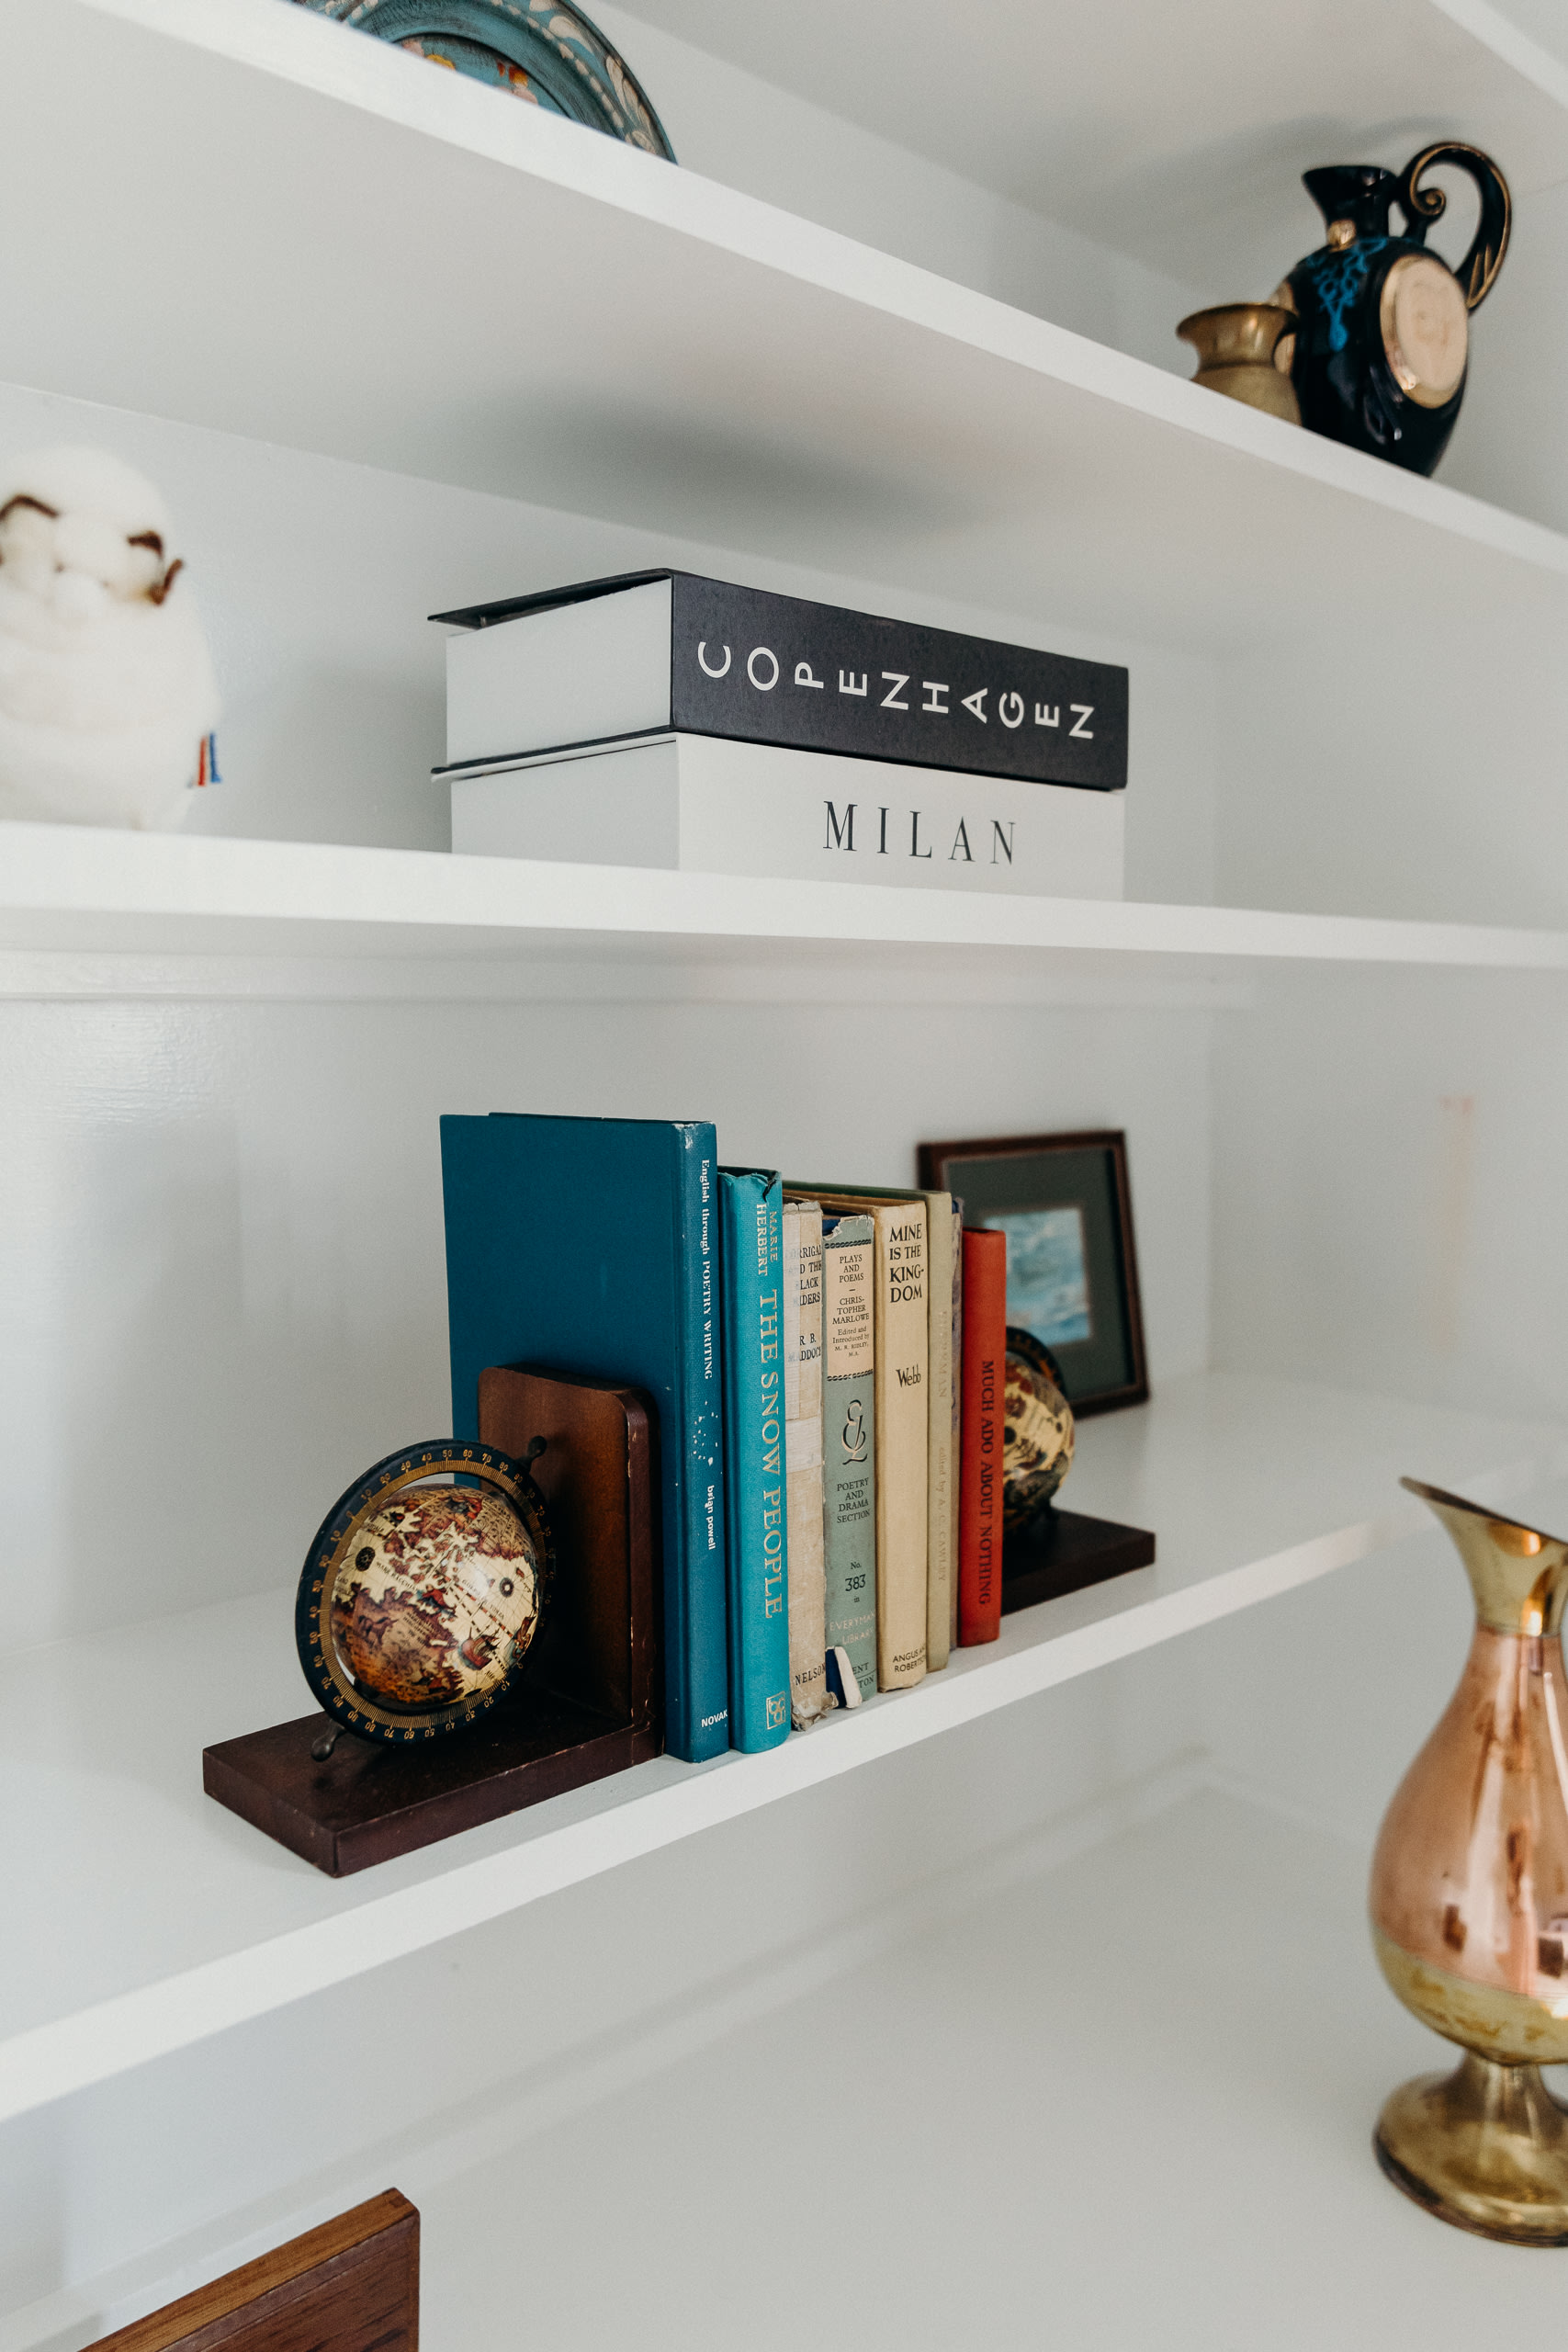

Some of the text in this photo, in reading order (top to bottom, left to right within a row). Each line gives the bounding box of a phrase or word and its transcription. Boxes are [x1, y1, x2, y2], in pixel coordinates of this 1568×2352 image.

[696, 640, 1095, 740] COPENHAGEN
[822, 800, 1016, 865] MILAN
[769, 1211, 778, 1263] MARIE
[889, 1223, 922, 1242] MINE
[756, 1204, 768, 1277] HERBERT
[840, 1254, 863, 1264] PLAYS
[889, 1244, 921, 1261] IS THE
[700, 1159, 713, 1380] English through POETRY WRITING
[843, 1263, 860, 1274] AND
[889, 1263, 925, 1283] KING-
[796, 1277, 818, 1290] LACK
[839, 1272, 864, 1283] POEMS
[890, 1283, 922, 1304] DOM
[839, 1295, 865, 1306] CHRIS-
[837, 1305, 866, 1315] TOPHER
[832, 1313, 870, 1325] MARLOWE
[838, 1326, 867, 1336] Edited and
[832, 1335, 863, 1344] Introduced
[896, 1363, 921, 1388] Webb
[422, 1453, 433, 1462] 40
[442, 1449, 452, 1457] 50
[482, 1453, 492, 1463] 70
[760, 1288, 783, 1619] THE SNOW PEOPLE
[837, 1477, 870, 1492] POETRY
[978, 1361, 995, 1605] MUCH ADO ABOUT NOTHING
[844, 1489, 863, 1501] AND
[838, 1498, 869, 1512] DRAMA
[705, 1485, 716, 1551] brian powell
[837, 1510, 870, 1524] SECTION
[850, 1562, 862, 1570] No.
[845, 1574, 866, 1591] 383
[892, 1648, 919, 1663] ANGUS
[852, 1662, 869, 1675] ENT
[484, 1697, 494, 1708] 20
[466, 1711, 476, 1722] 30
[701, 1708, 728, 1728] NOVAK
[384, 1728, 394, 1738] 70
[403, 1730, 415, 1739] 60
[424, 1728, 435, 1737] 50
